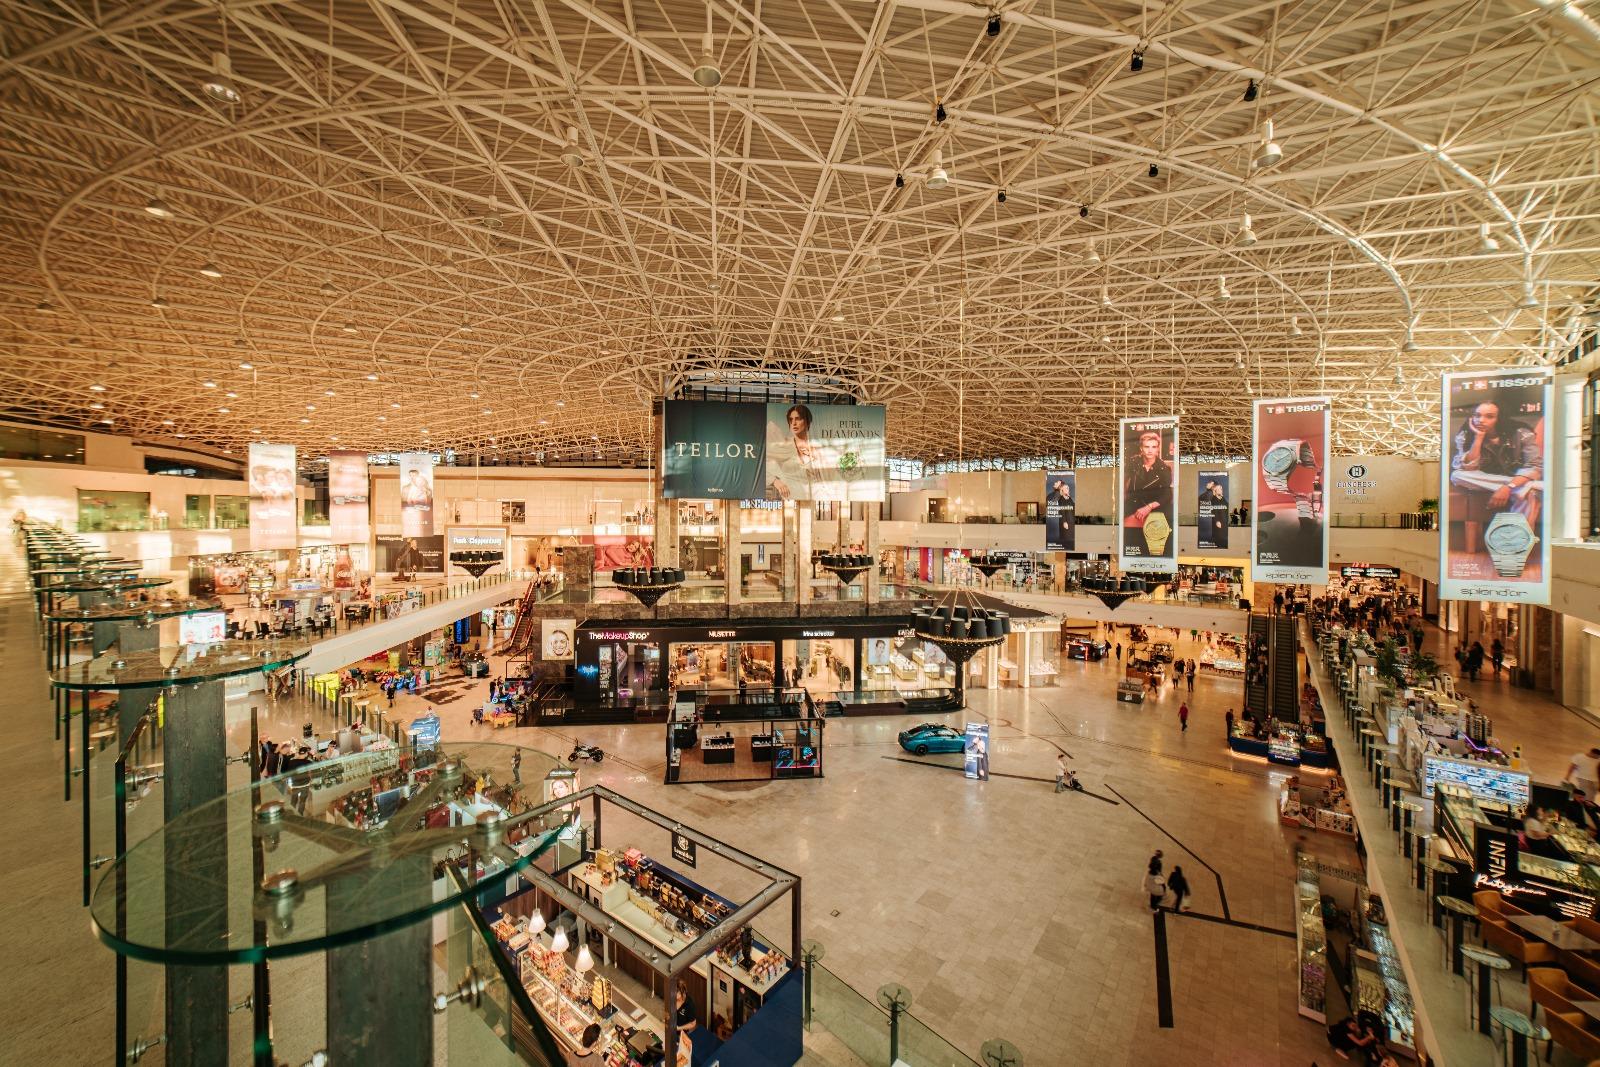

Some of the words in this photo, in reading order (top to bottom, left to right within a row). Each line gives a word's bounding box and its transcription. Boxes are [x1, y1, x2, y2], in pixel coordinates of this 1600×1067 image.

[1488, 377, 1546, 388] TISSOT
[1286, 404, 1326, 413] TISSOT
[839, 420, 863, 429] PURE
[1144, 422, 1176, 430] TISSOT
[821, 429, 880, 439] DIAMONDS
[675, 442, 756, 459] TEILOR
